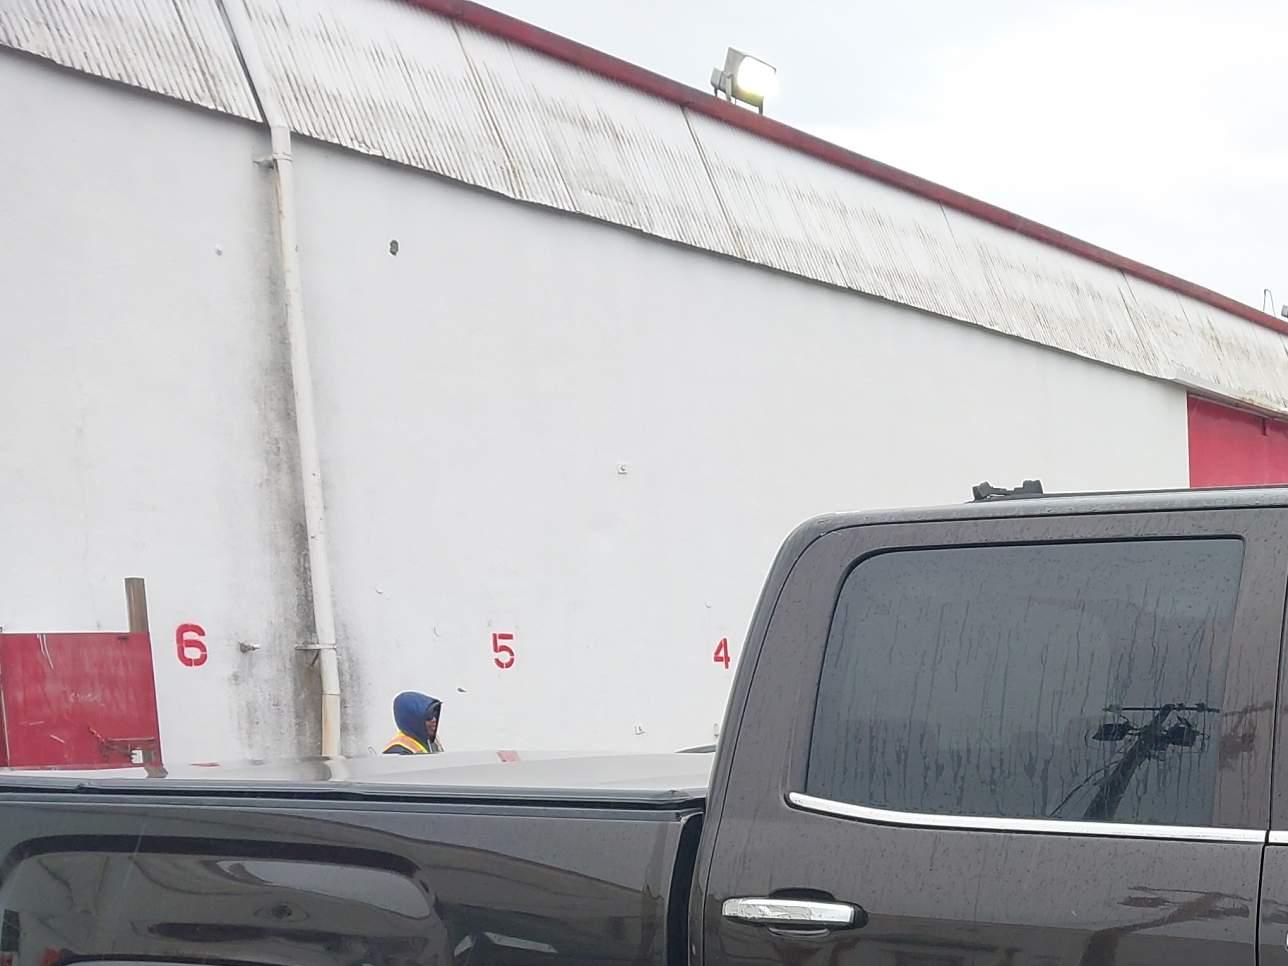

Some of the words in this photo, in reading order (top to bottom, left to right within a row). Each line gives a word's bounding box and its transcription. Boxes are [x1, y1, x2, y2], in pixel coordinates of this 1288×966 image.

[175, 623, 208, 668] 6
[492, 633, 515, 669] 5
[713, 637, 731, 669] 4
